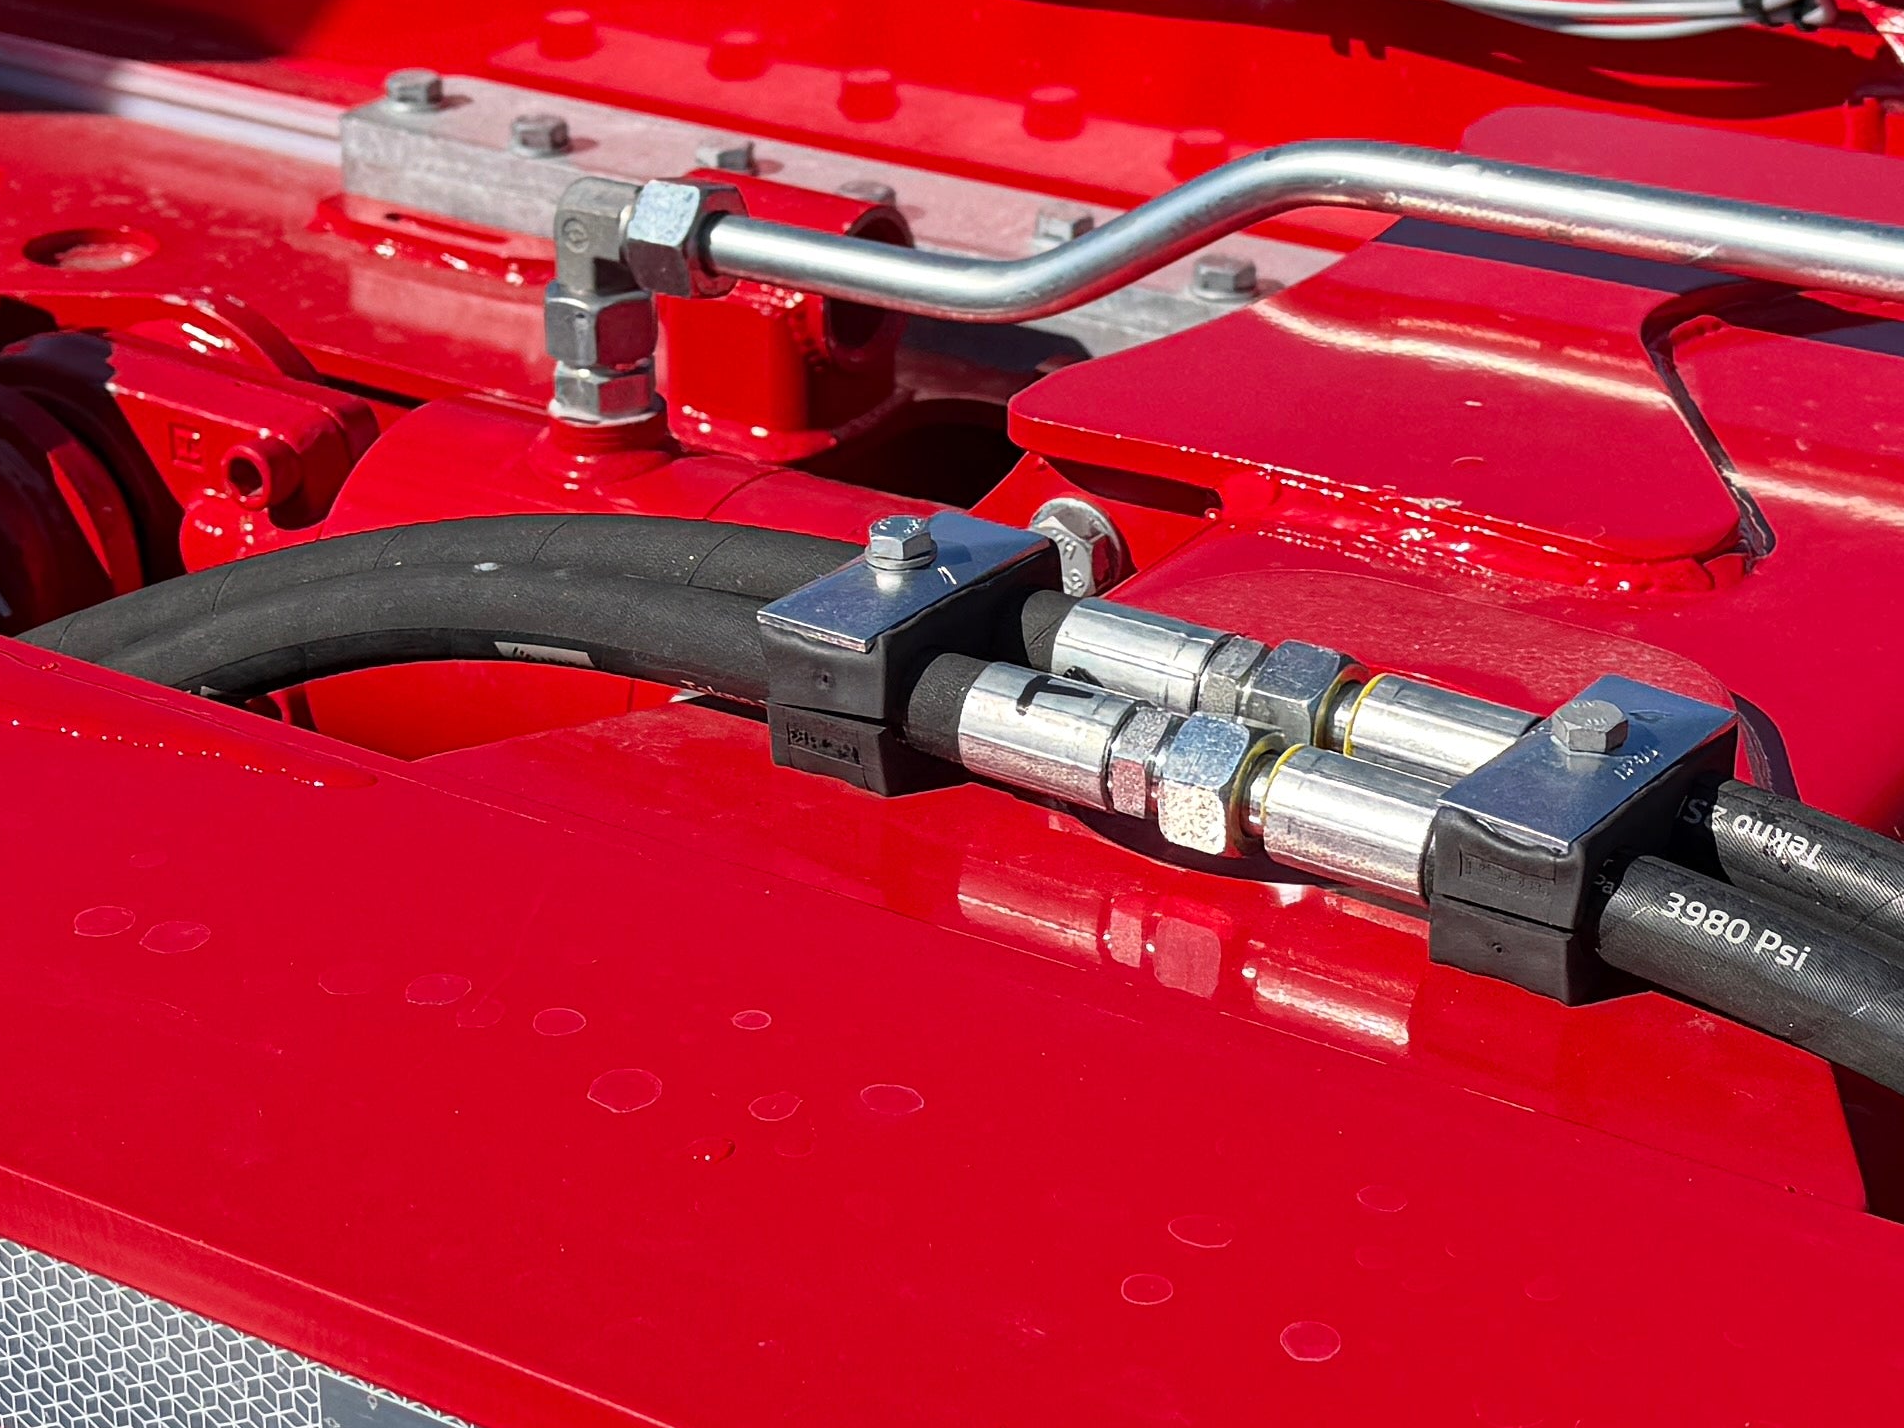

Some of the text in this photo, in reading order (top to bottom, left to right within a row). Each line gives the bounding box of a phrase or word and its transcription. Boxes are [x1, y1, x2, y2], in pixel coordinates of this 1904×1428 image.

[1732, 814, 1823, 872] Tekno
[1660, 891, 1812, 972] 3980 Psi
